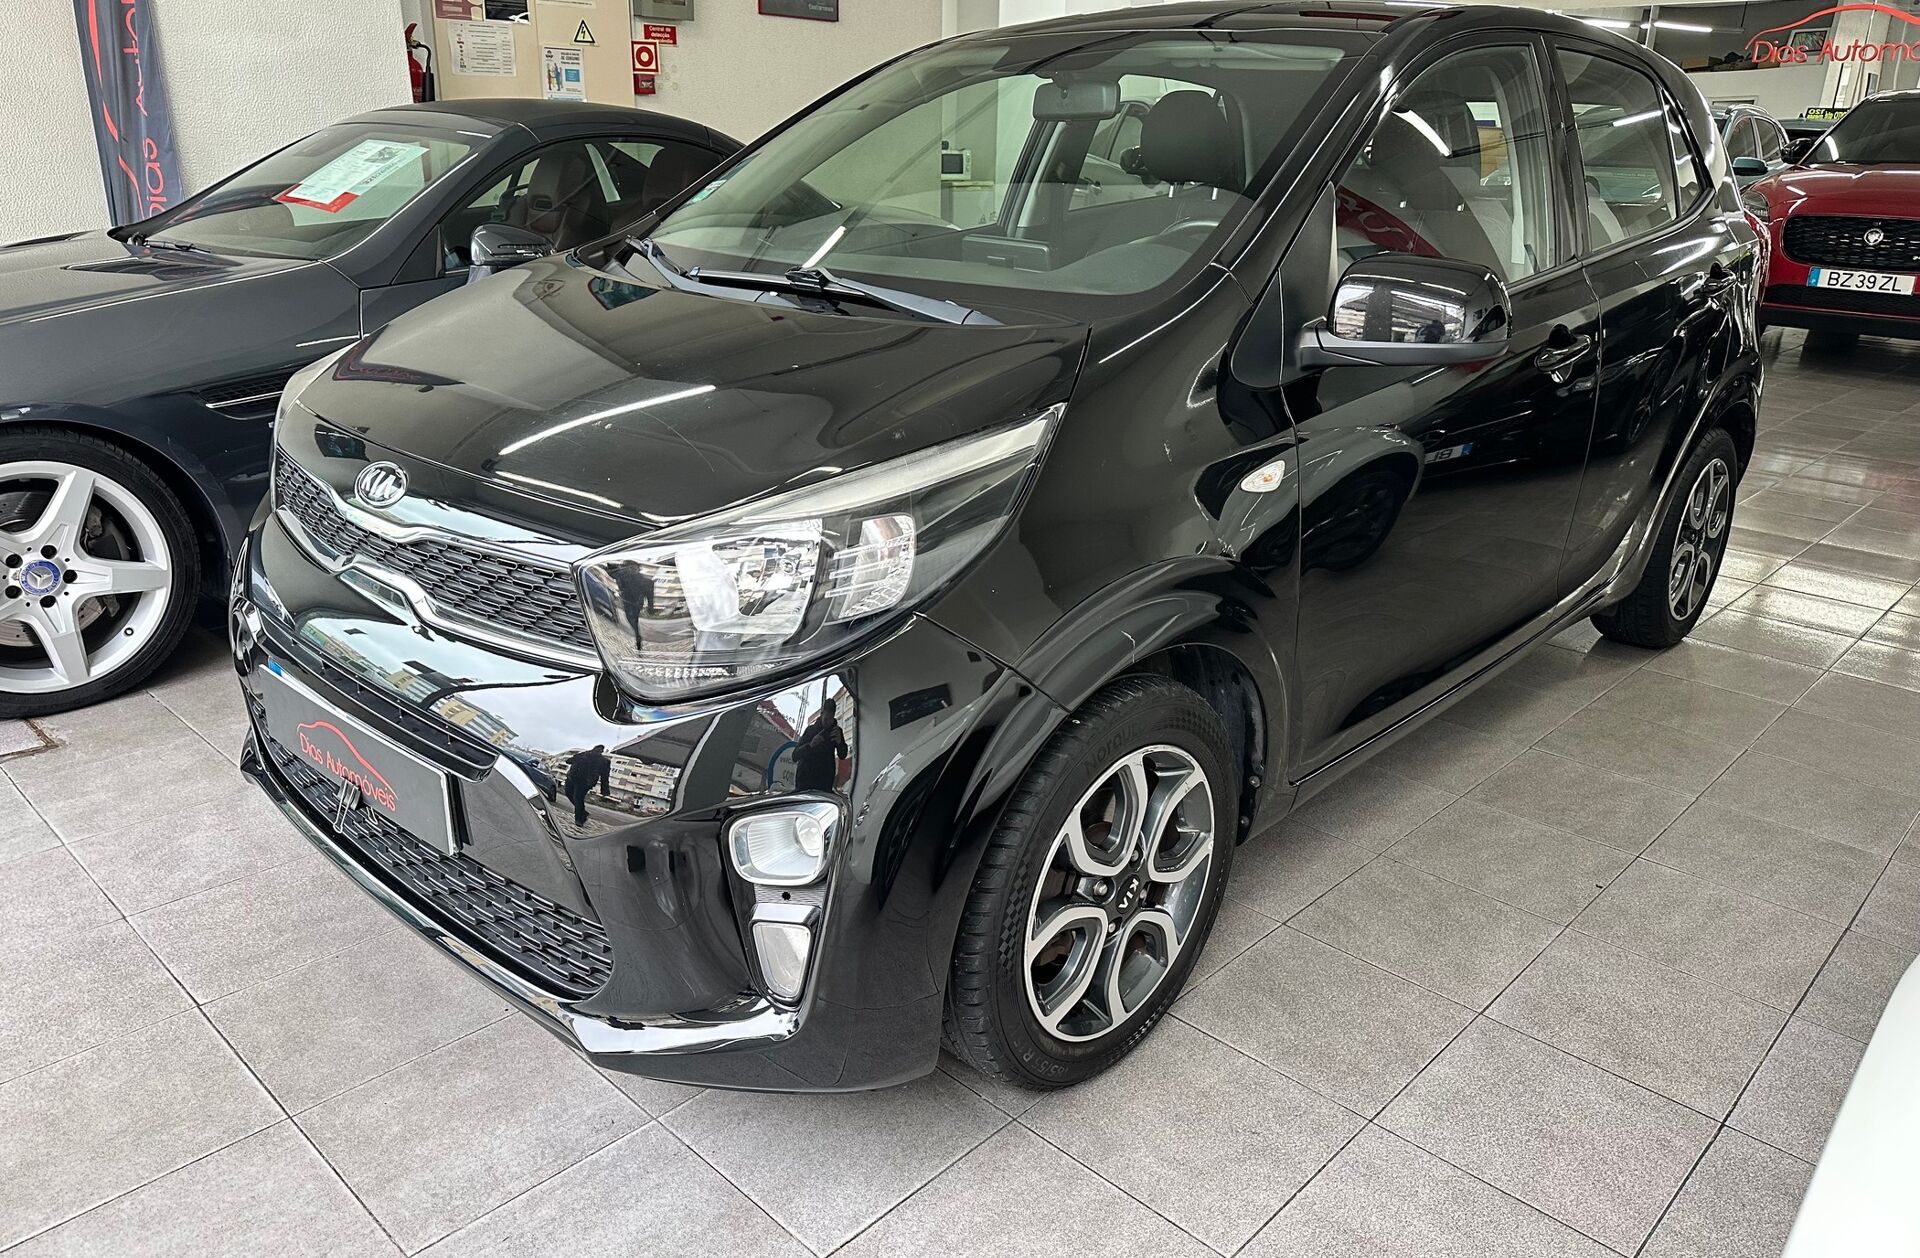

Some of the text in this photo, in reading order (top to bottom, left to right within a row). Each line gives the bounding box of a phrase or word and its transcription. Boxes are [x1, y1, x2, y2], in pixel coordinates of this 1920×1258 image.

[1751, 39, 1809, 64] Dias
[1827, 271, 1901, 292] BZ 39 ZL
[300, 732, 397, 812] Dias Automóveis
[1118, 878, 1139, 908] KIA
